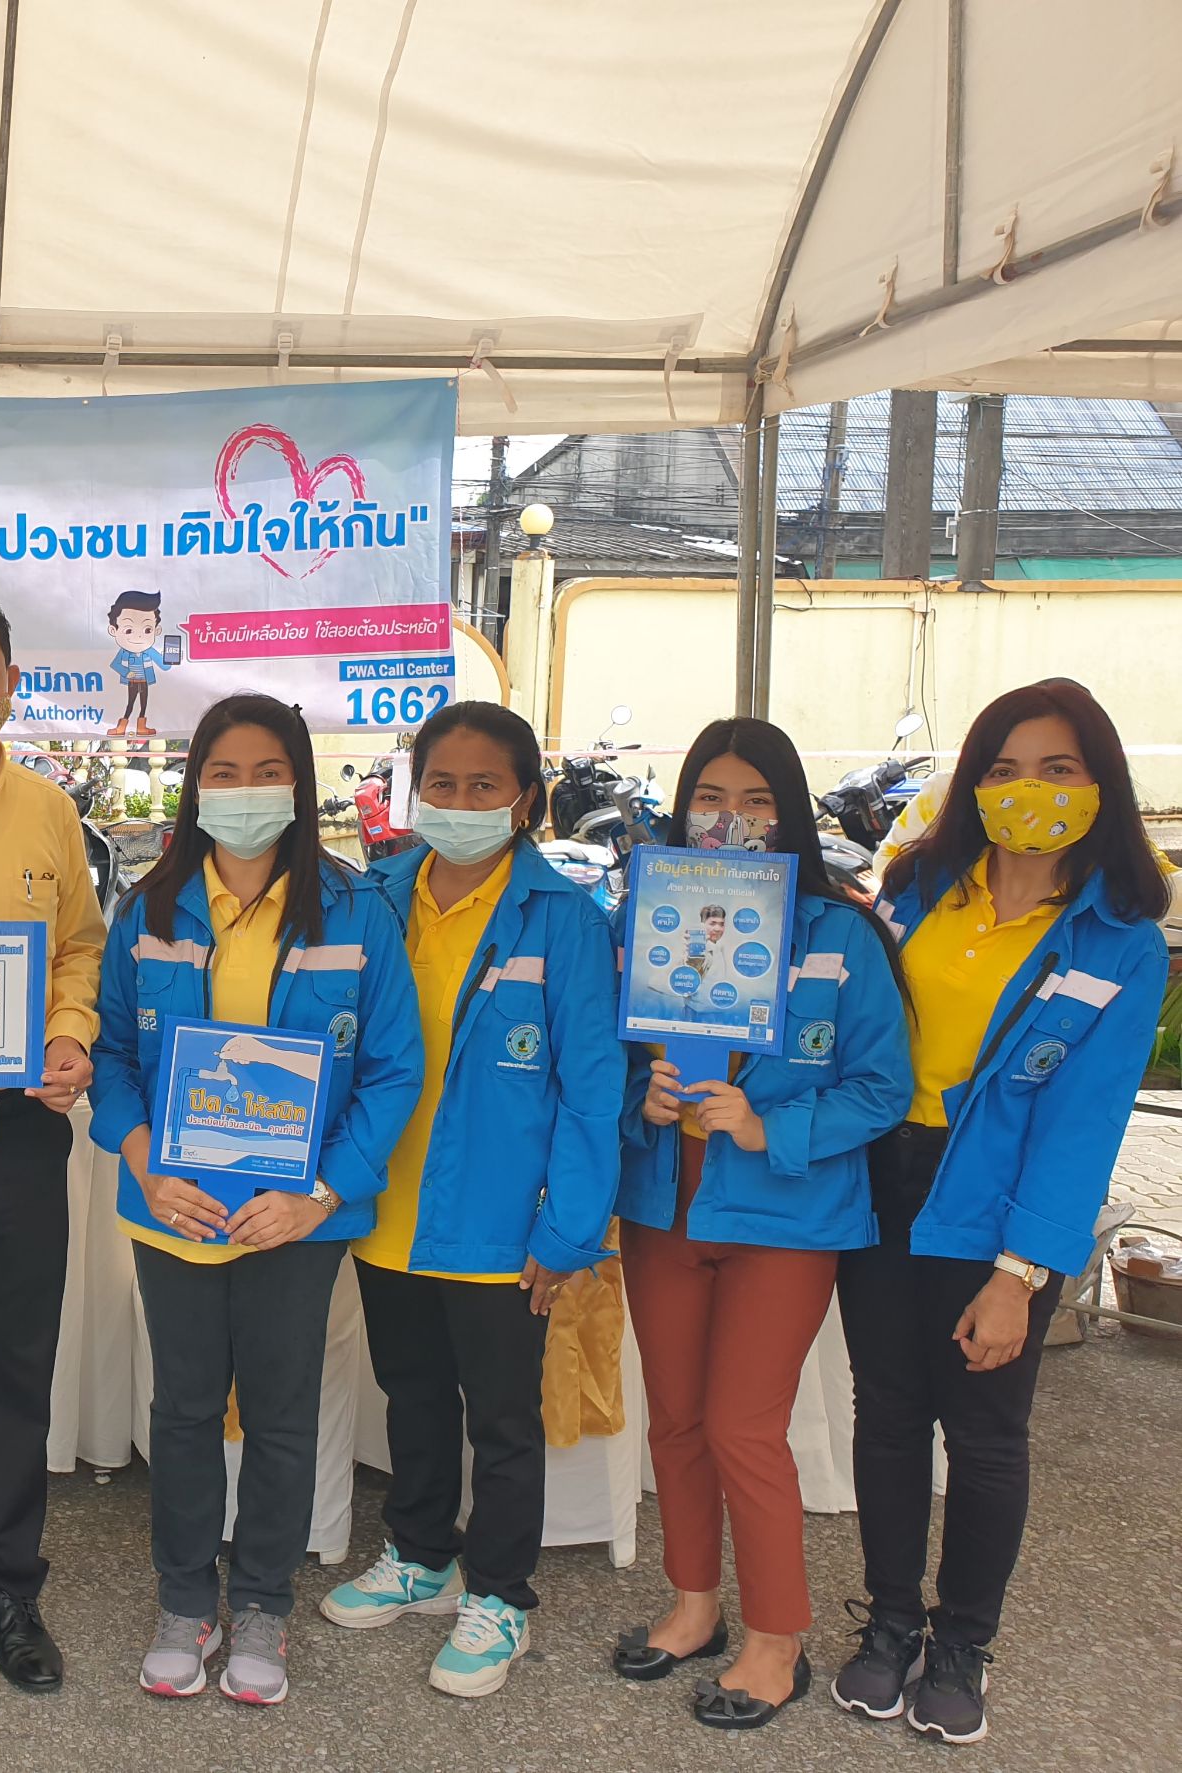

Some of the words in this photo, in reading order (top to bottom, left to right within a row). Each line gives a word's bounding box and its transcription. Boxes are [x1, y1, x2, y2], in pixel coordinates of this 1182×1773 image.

[163, 500, 428, 558] เติมใจให้กัน"
[347, 665, 376, 678] PWA
[379, 664, 404, 677] Call
[408, 662, 449, 676] Center
[24, 705, 104, 725] Authority
[346, 685, 449, 725] 1662
[189, 1088, 221, 1113] ปิด
